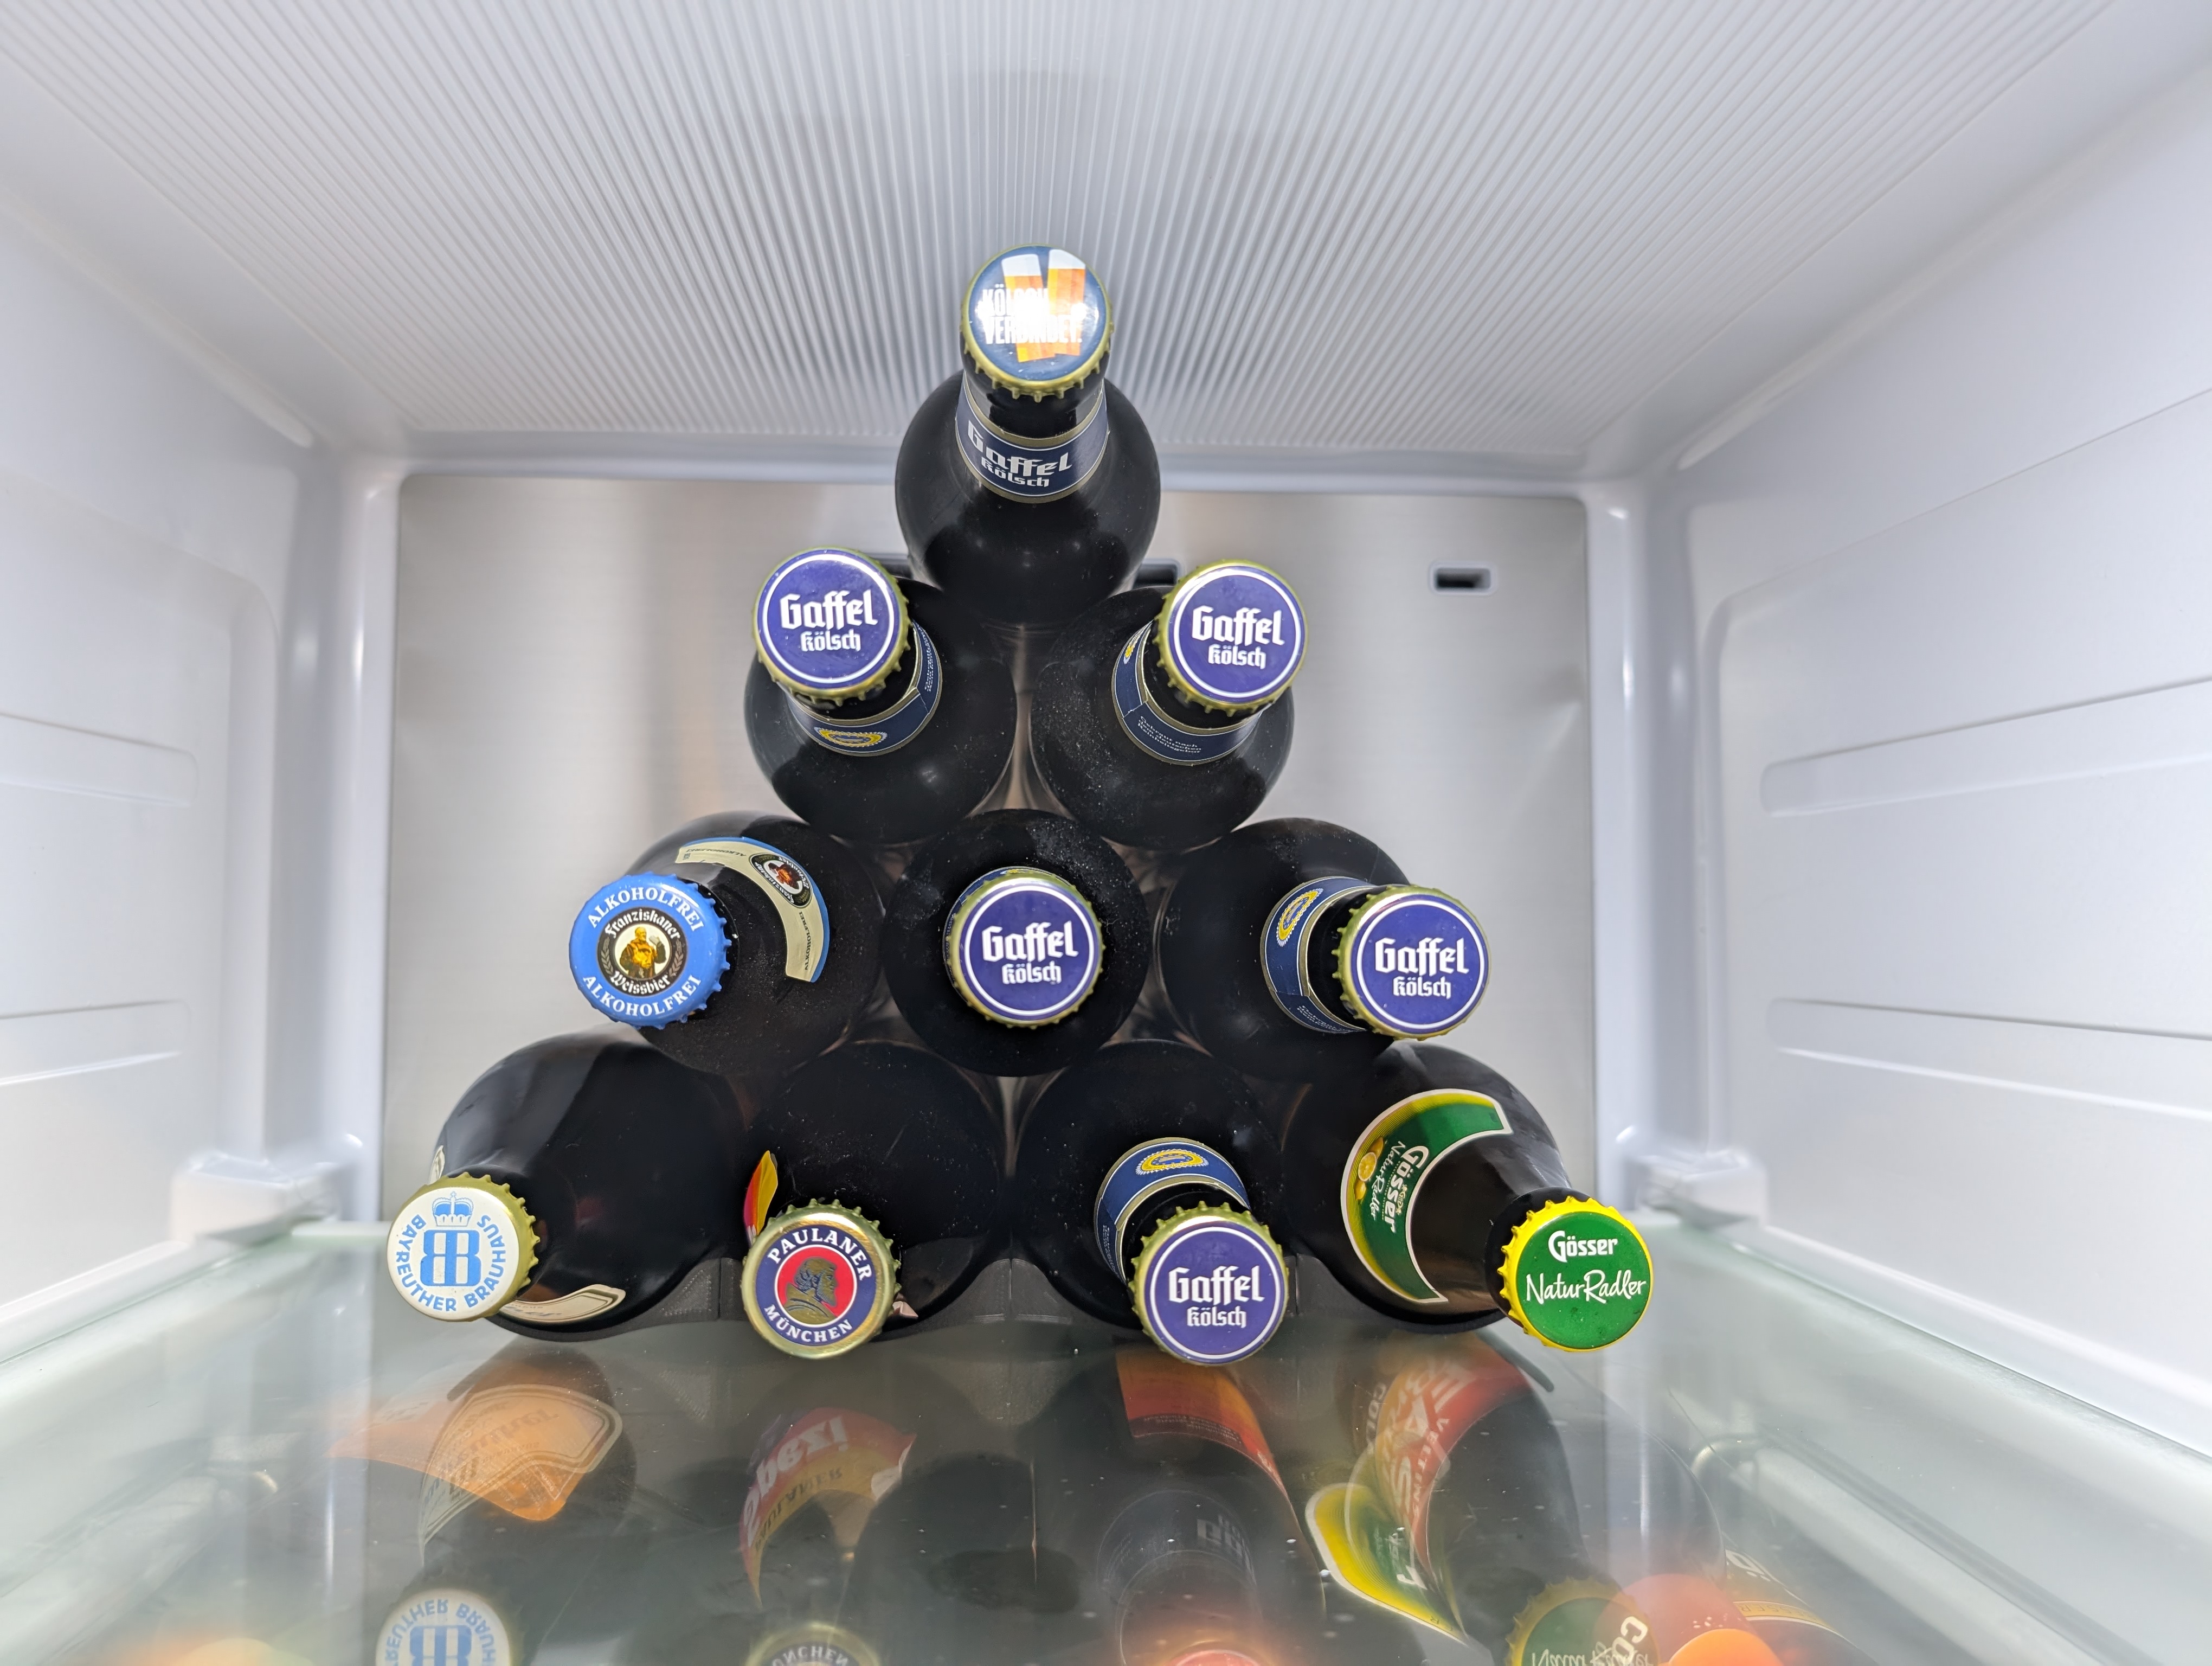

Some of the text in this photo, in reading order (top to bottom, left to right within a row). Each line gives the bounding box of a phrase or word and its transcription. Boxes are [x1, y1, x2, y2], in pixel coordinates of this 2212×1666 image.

[967, 420, 1072, 477] Gaffel
[780, 589, 878, 630] Gaffel
[1191, 606, 1285, 646] Gaffel
[587, 887, 704, 933] ALKOHOLFREI
[605, 910, 681, 939] Franziskaner
[799, 911, 812, 971] ALKOHOLFREI
[982, 921, 1078, 963] Gaffel
[1374, 937, 1469, 976] Gaffel
[583, 973, 702, 1016] ALKOHOLFREI
[610, 970, 670, 995] Weissbier
[1385, 1145, 1429, 1233] Gösser
[395, 1214, 507, 1312] BAYREUTHER BRAUHAUS
[767, 1228, 873, 1280] PAULANER
[1548, 1231, 1618, 1263] Gösser
[1168, 1266, 1265, 1305] Gaffel
[764, 1304, 853, 1343] MÜNCHEN
